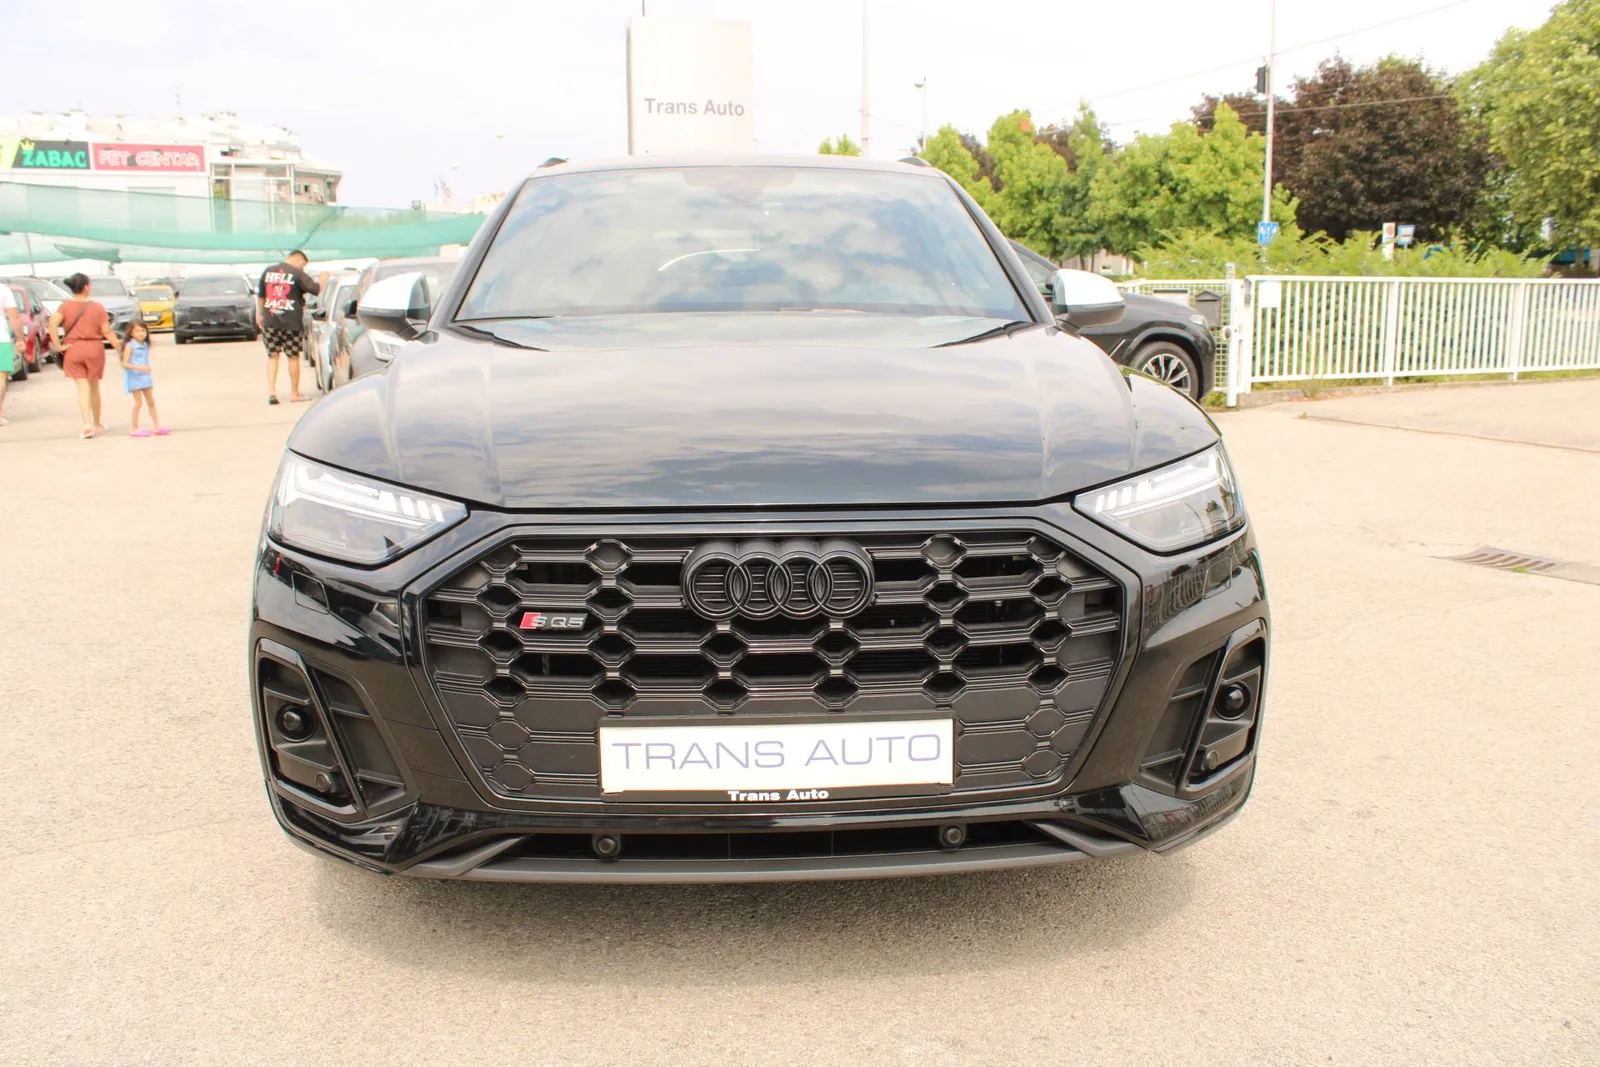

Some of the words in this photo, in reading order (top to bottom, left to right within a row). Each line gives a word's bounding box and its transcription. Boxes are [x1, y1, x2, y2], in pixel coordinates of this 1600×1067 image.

[643, 98, 698, 115] Trans
[703, 99, 745, 117] Auto
[98, 149, 131, 167] PET
[135, 150, 201, 168] CENTAR
[264, 271, 295, 285] HELL
[611, 740, 786, 770] TRANS
[804, 733, 942, 767] AUTO
[727, 789, 781, 802] Trans
[786, 788, 830, 800] Auto
